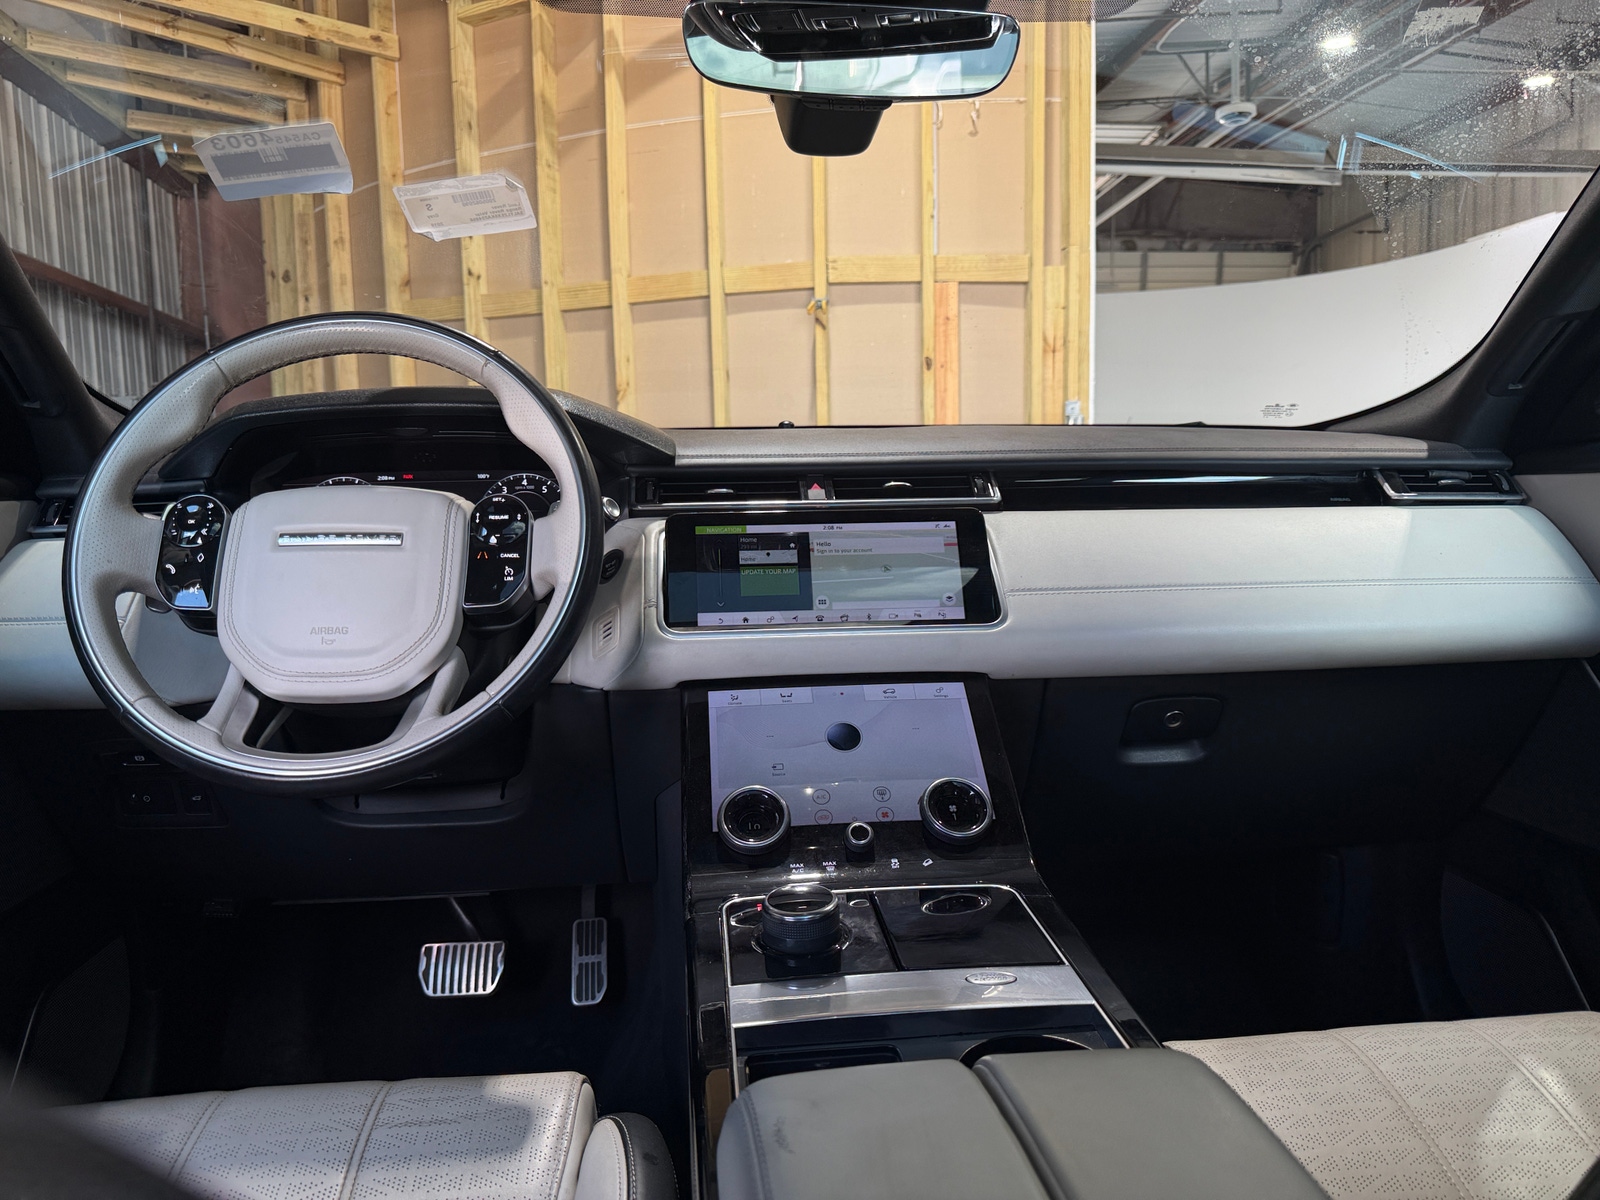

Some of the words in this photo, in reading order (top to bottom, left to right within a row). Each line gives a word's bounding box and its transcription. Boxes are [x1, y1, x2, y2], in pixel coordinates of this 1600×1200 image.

[501, 486, 508, 494] 3
[541, 485, 548, 494] 5
[310, 626, 349, 635] AIRBAG
